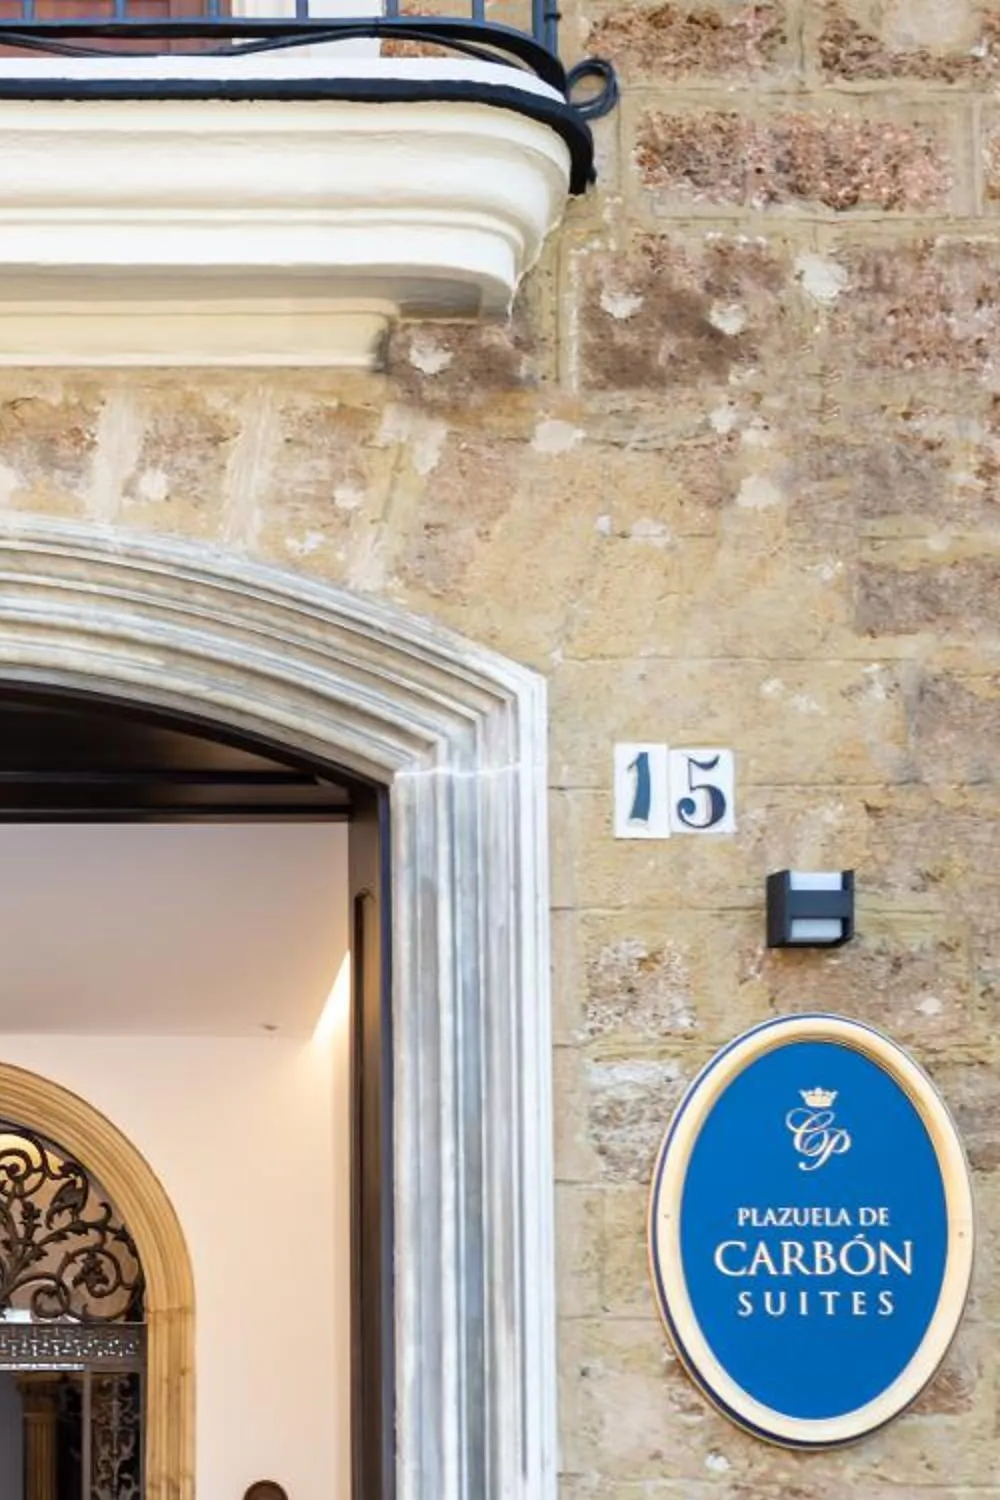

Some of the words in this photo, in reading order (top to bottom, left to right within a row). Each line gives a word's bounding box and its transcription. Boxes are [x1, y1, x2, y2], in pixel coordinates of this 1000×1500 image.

[626, 751, 726, 829] 15
[737, 1207, 851, 1226] PLAZUELA
[859, 1207, 889, 1226] DE
[713, 1233, 913, 1276] CARBÓN
[738, 1291, 894, 1315] SUITES
